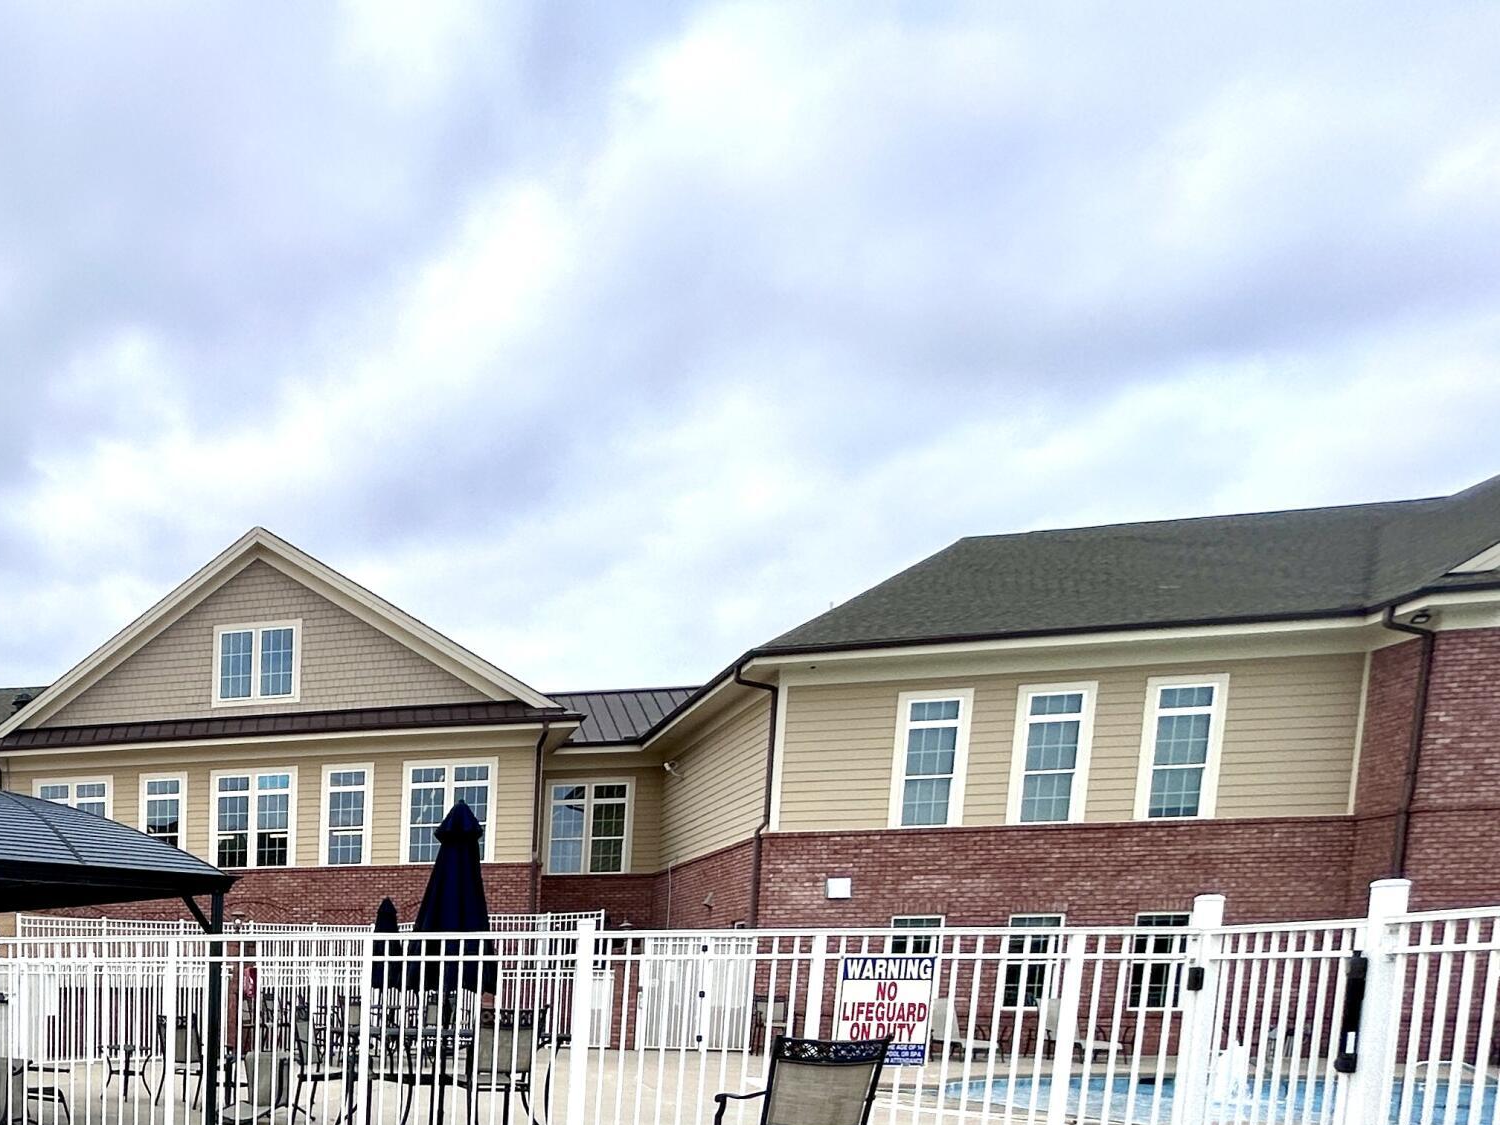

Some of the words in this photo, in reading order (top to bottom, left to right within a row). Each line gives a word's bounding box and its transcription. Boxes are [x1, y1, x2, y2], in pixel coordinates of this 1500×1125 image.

[846, 959, 932, 979] WARNING
[876, 981, 898, 1001] NO
[842, 1001, 927, 1022] LIFEGUARD
[849, 1022, 871, 1041] ON
[875, 1022, 916, 1042] DUTY
